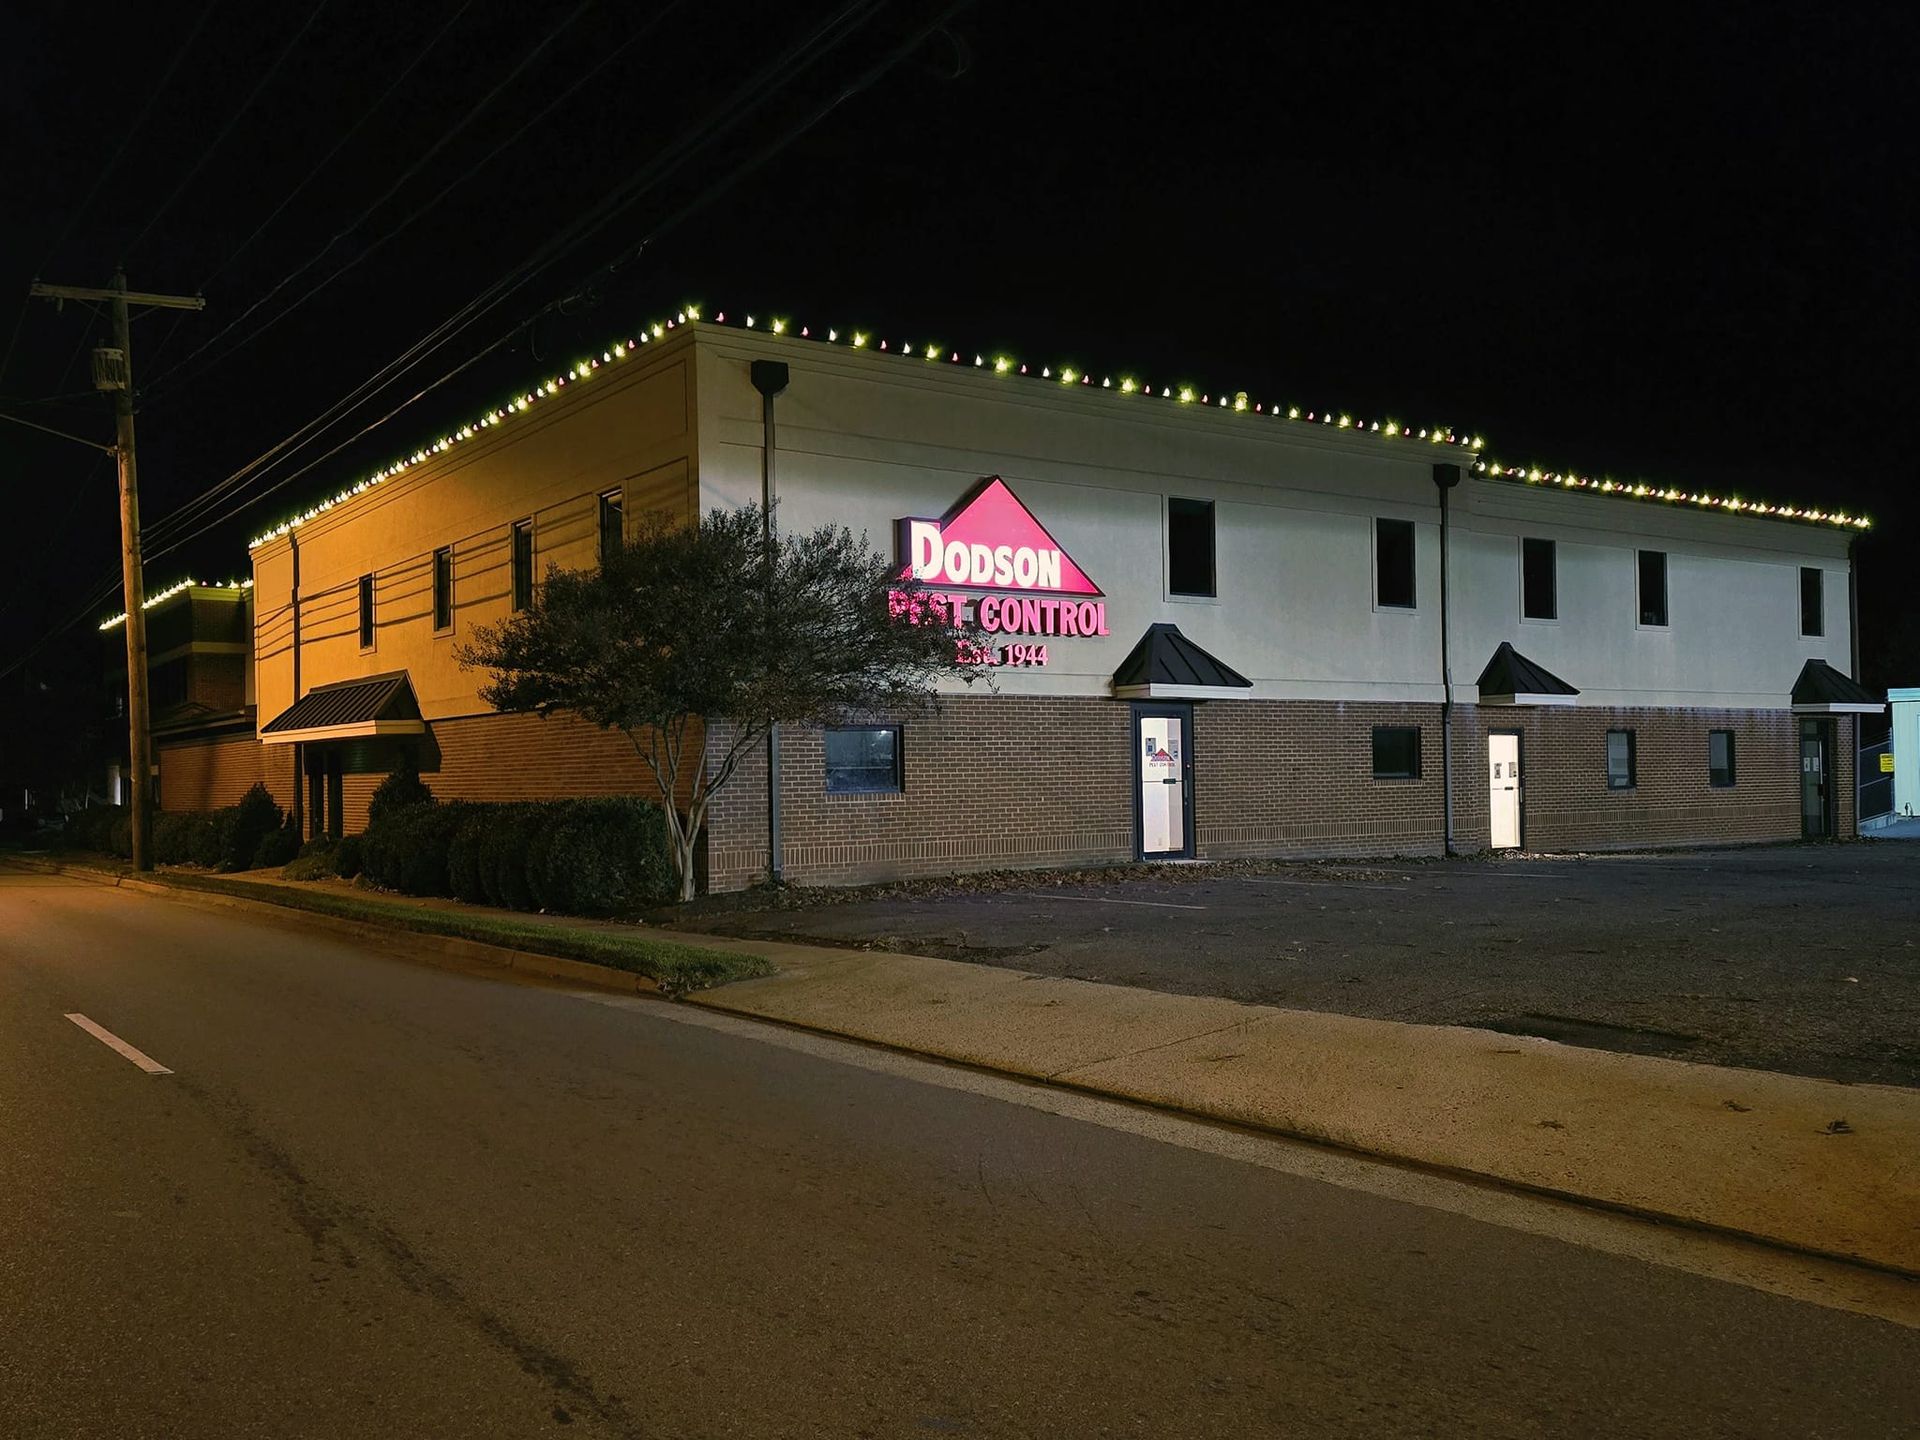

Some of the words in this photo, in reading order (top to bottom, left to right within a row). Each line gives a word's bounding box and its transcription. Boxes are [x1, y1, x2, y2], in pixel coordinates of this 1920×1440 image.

[911, 520, 1061, 588] DODSON
[980, 596, 1110, 636] CONTROL
[1005, 643, 1049, 666] 1944
